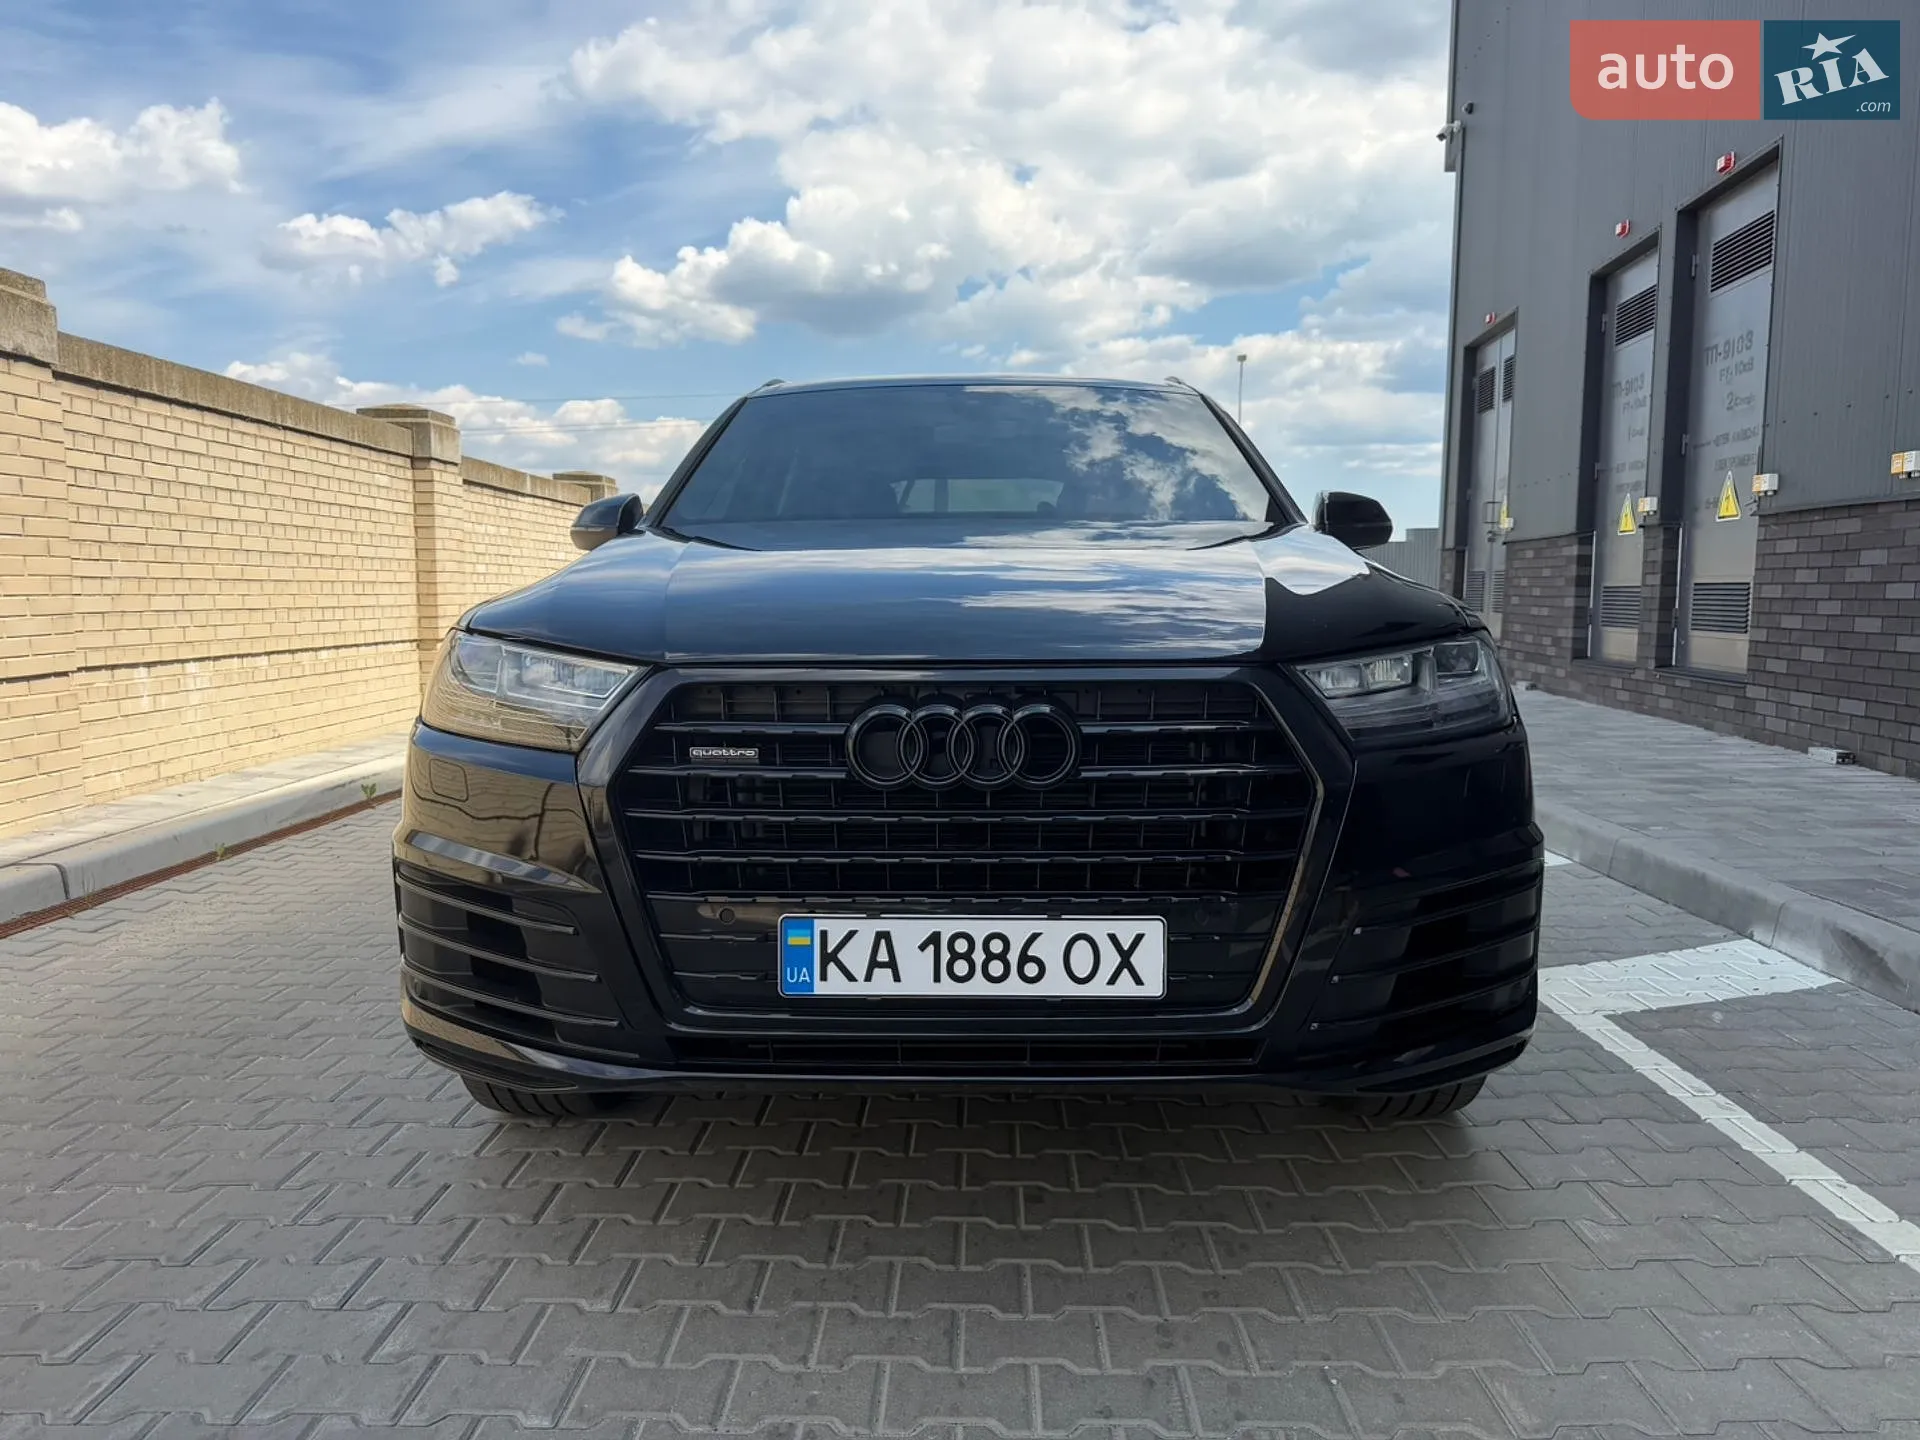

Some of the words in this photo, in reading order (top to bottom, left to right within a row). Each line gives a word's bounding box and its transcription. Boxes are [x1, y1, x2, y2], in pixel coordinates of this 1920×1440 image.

[692, 748, 756, 759] quattro
[818, 929, 902, 983] KA
[917, 930, 1047, 985] 1886
[1062, 932, 1146, 986] OX
[786, 967, 811, 983] UA
